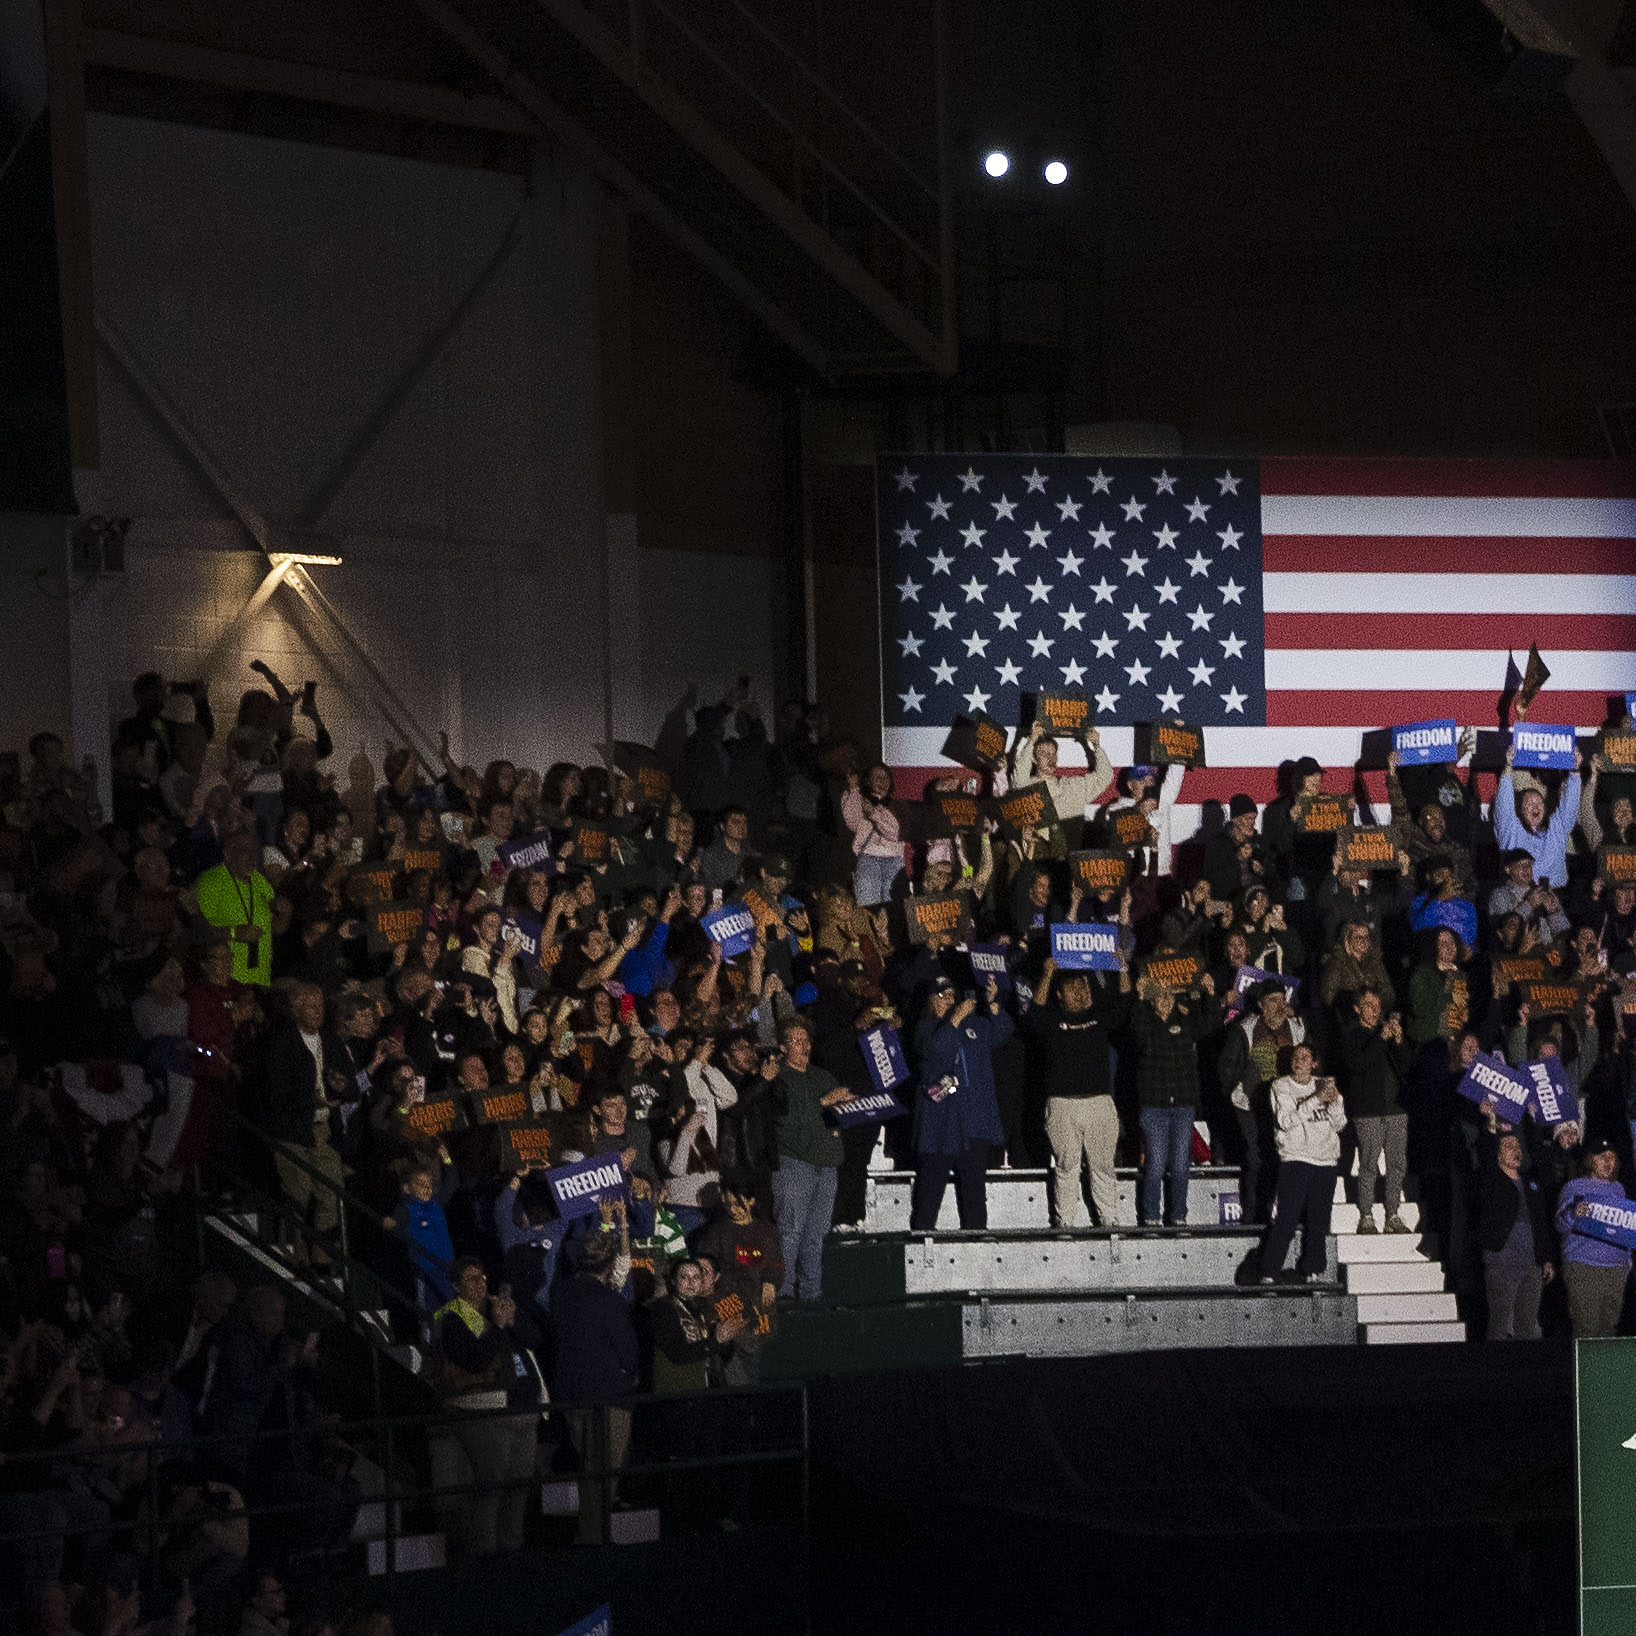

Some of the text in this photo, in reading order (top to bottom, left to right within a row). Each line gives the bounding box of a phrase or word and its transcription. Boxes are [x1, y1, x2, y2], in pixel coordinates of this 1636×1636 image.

[1044, 698, 1088, 718] HARRIS
[1396, 727, 1453, 750] FREEDOM
[1516, 732, 1573, 754] FREEDOM
[1079, 858, 1125, 880] HARRIS
[915, 899, 961, 926] HARRIS
[709, 911, 755, 942] FREEDOM
[1055, 932, 1116, 953] FREEDOM
[970, 952, 1007, 973] FREEDOM
[1147, 956, 1198, 984] HARRIS
[867, 1029, 897, 1088] FREEDOM
[1469, 1062, 1529, 1106] FREEDOM
[1528, 1063, 1561, 1122] FREEDOM
[555, 1164, 623, 1200] FREEDOM
